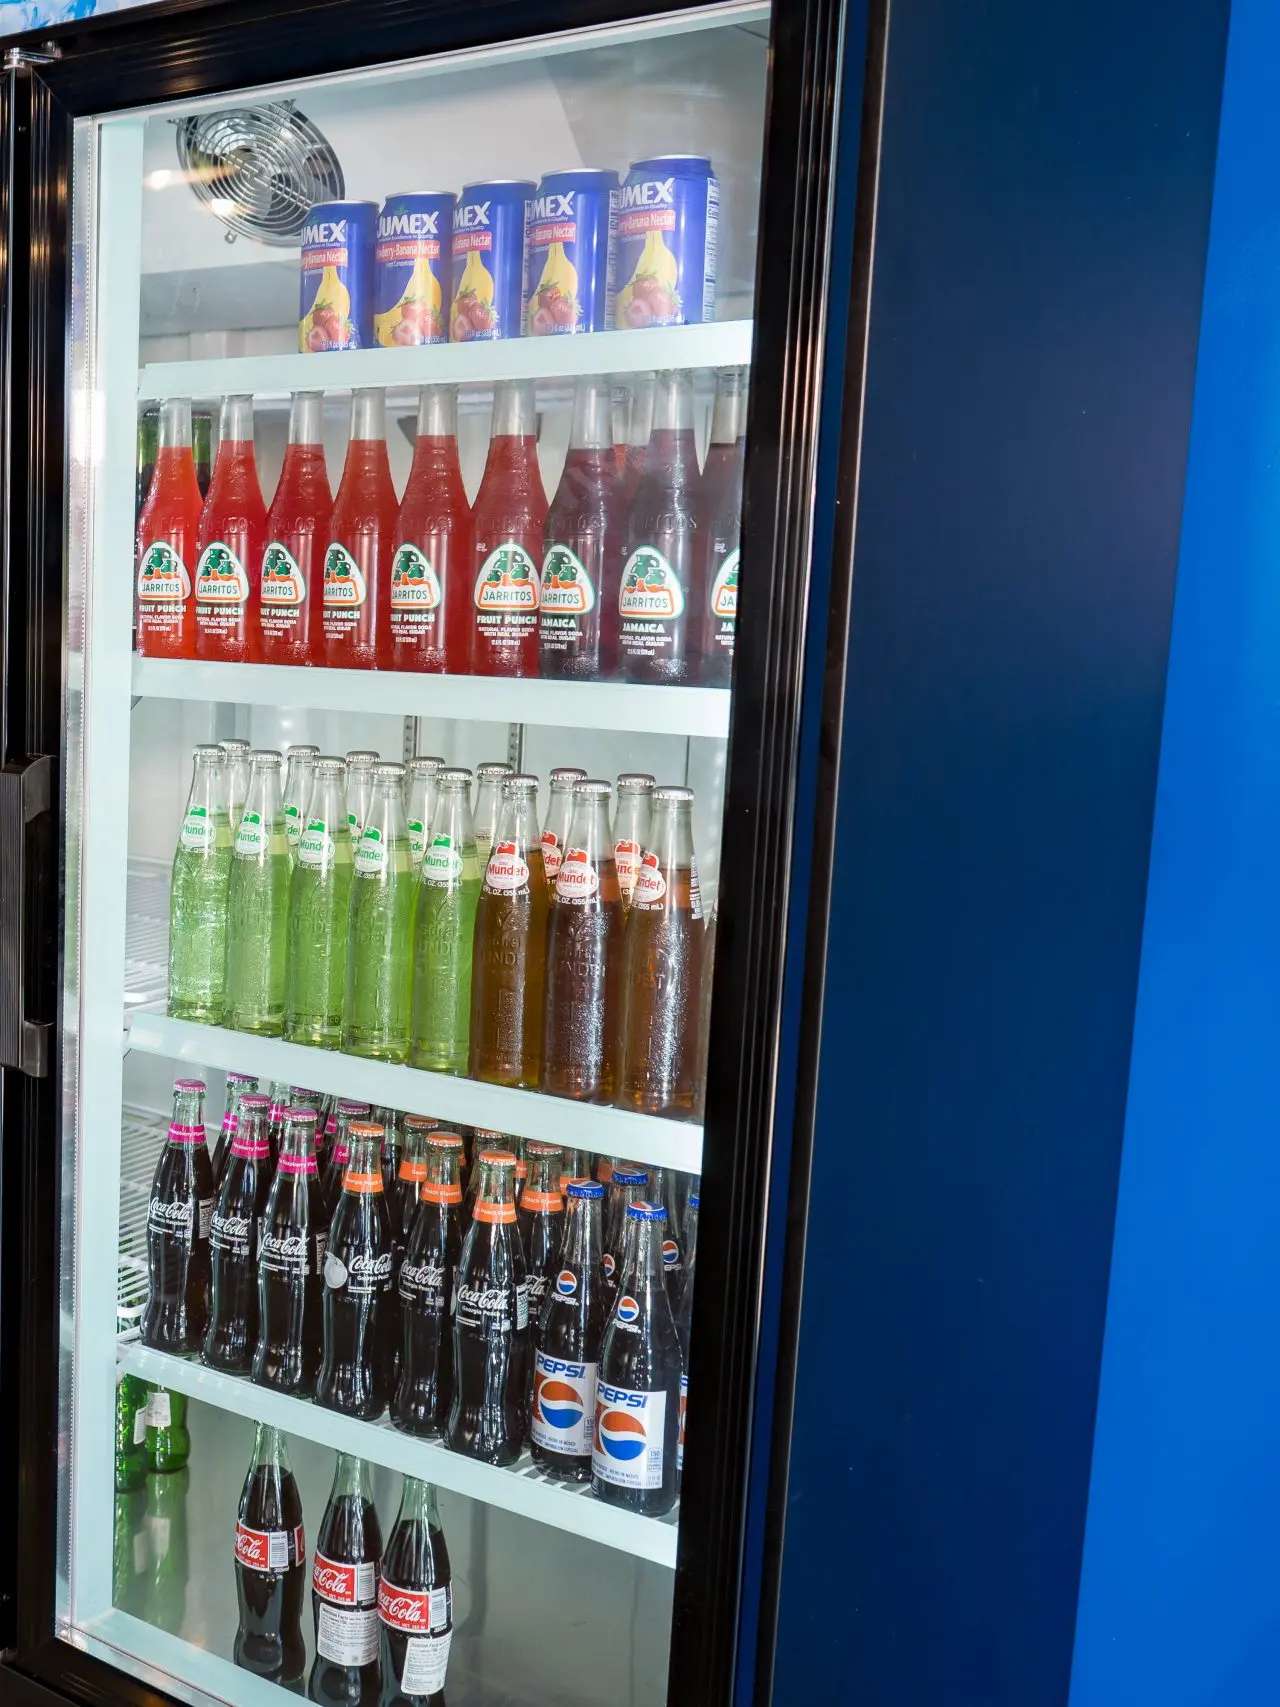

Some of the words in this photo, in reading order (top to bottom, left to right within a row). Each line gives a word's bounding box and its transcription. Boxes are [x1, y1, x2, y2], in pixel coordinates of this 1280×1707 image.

[618, 177, 674, 208] UMEX
[453, 202, 490, 229] MEX
[301, 219, 347, 244] UMEX
[142, 583, 180, 593] JARRITOS
[199, 584, 238, 595] JARRITOS
[262, 586, 293, 596] ARRITOS
[324, 586, 353, 598] ARRITOS
[483, 591, 532, 602] JARRITOS
[622, 597, 668, 608] JARRITOS
[156, 605, 186, 613] PUNCH
[214, 607, 244, 616] PUNCH
[271, 608, 300, 618] PUNCH
[332, 611, 360, 620] PUNCH
[404, 614, 435, 622] PUNCH
[504, 615, 538, 624] PUNCH
[622, 622, 666, 633] JAMAICA
[544, 856, 560, 867] det
[488, 864, 525, 876] Mundet
[639, 877, 662, 890] ndet
[664, 1264, 682, 1272] EPSI
[551, 1292, 576, 1306] PEPSI
[612, 1318, 638, 1333] PEPSI
[537, 1354, 586, 1379] PEPSI
[597, 1382, 648, 1409] PEPSI
[235, 1532, 262, 1558] -Cola
